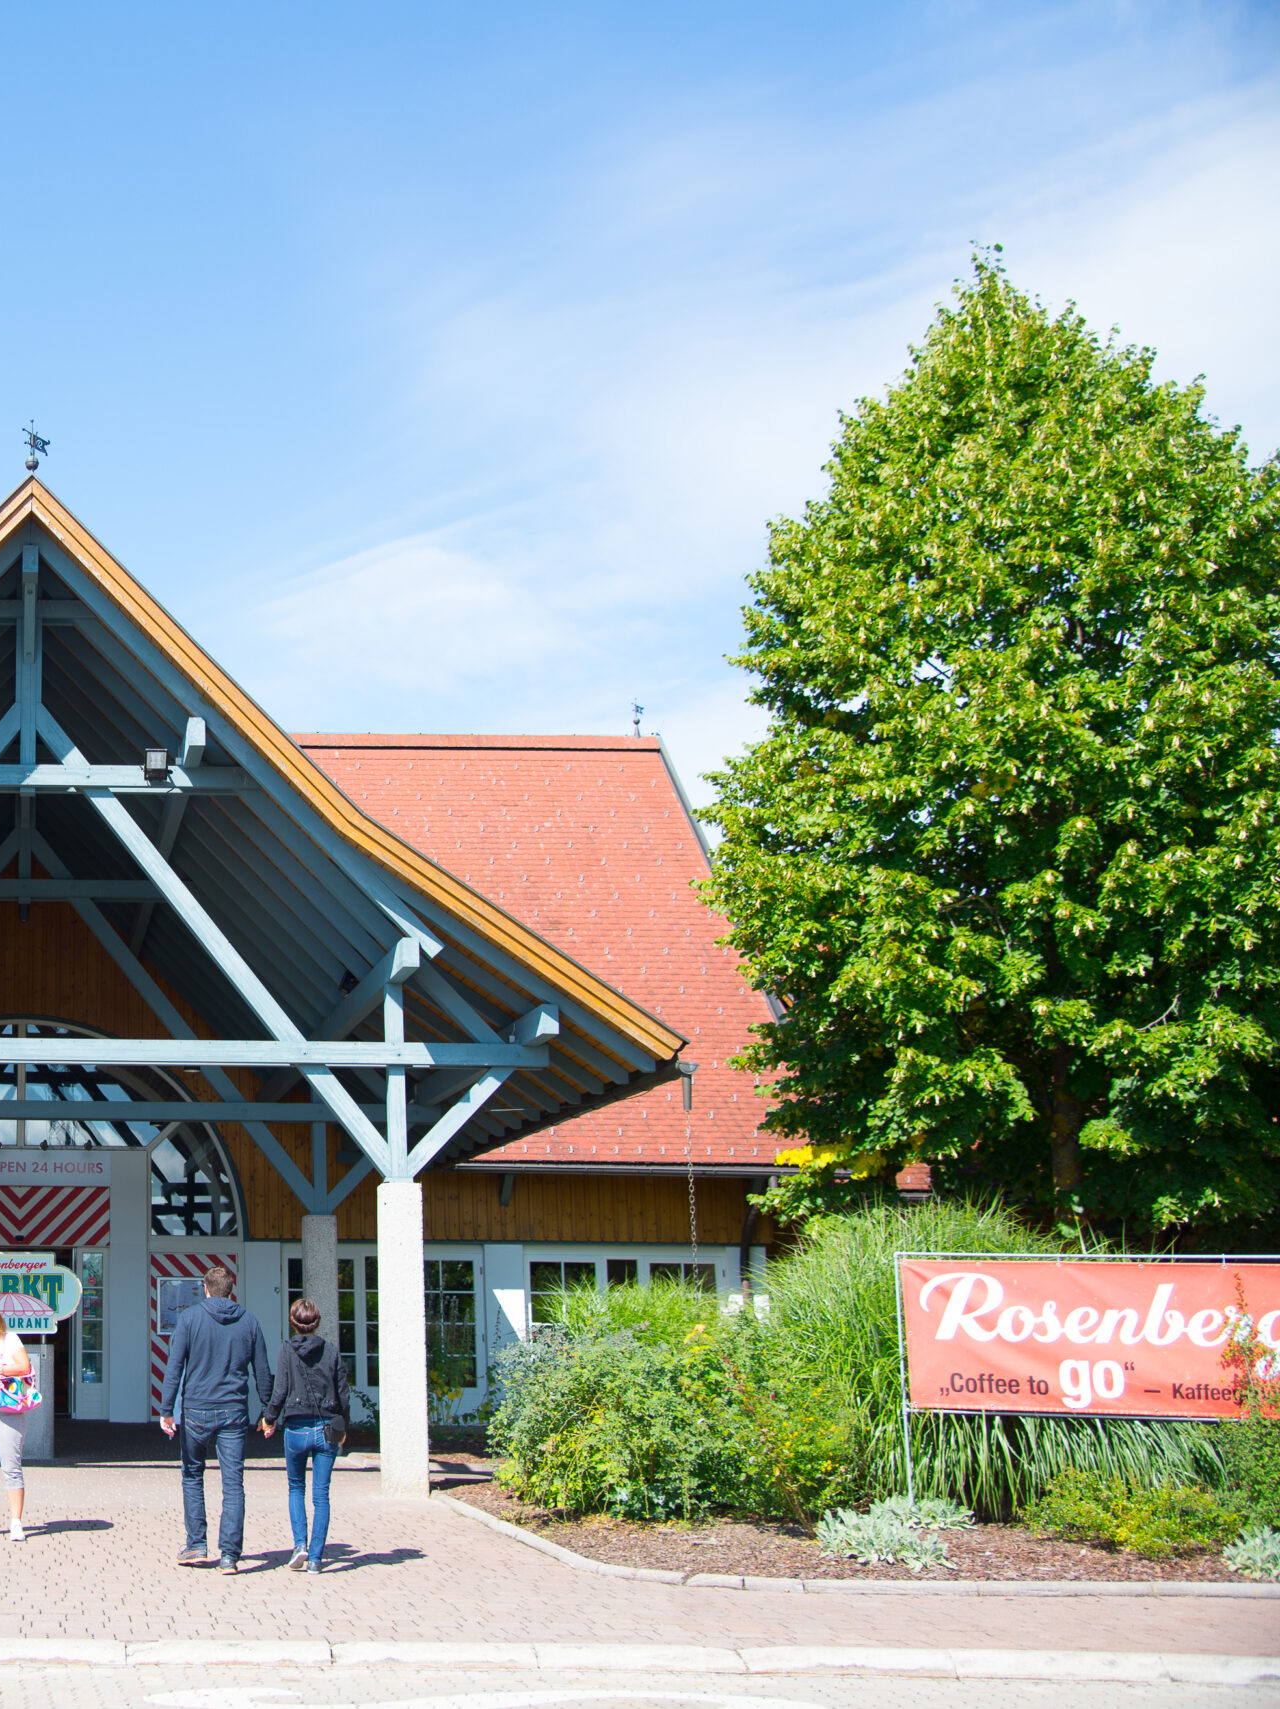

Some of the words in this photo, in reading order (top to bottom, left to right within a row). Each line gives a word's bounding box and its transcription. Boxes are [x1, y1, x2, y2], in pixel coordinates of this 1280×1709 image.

[31, 1161, 49, 1174] 24
[53, 1161, 104, 1175] HOURS
[1027, 1375, 1050, 1396] to
